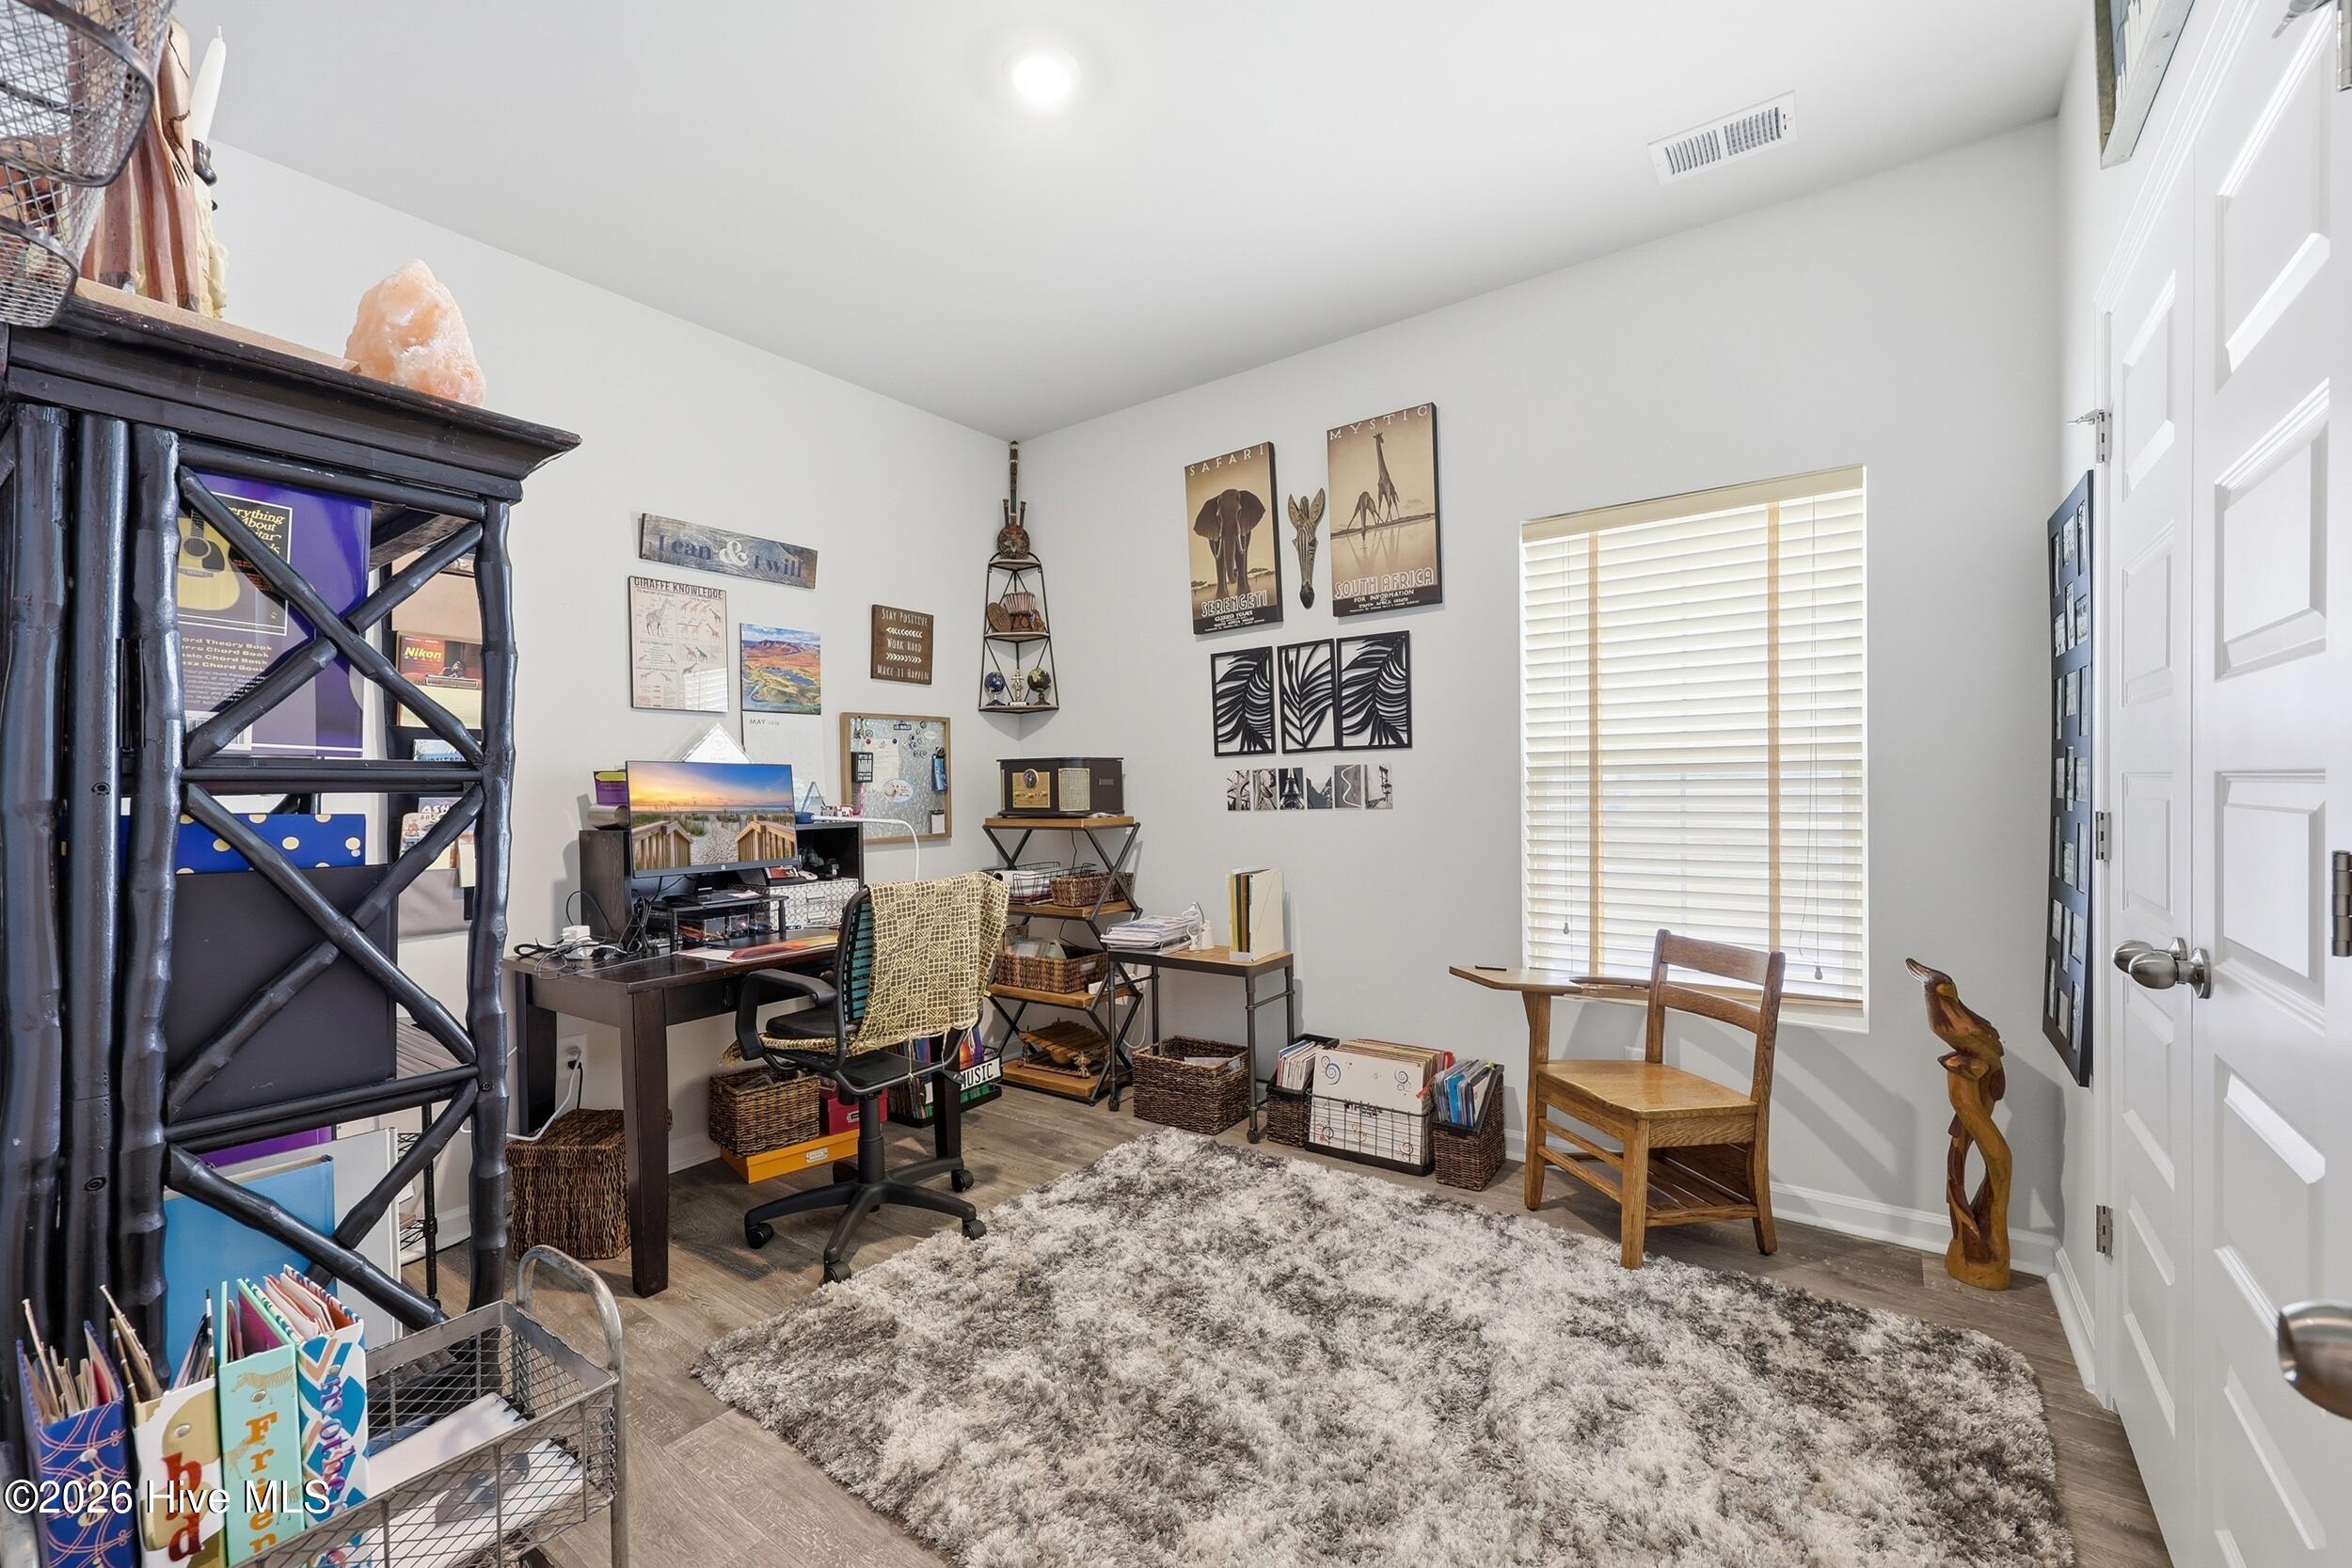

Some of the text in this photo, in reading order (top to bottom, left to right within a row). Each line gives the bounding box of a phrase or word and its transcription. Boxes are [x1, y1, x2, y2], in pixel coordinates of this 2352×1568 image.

[1329, 405, 1428, 440] MYSTIC
[1189, 445, 1263, 476] SAFARI
[229, 507, 286, 525] erything
[243, 517, 277, 532] About
[672, 539, 711, 562] can
[719, 540, 750, 567] &
[766, 556, 803, 578] will
[634, 577, 670, 591] GIRAFFE
[673, 582, 723, 599] KNOWLEDGE
[1335, 566, 1434, 599] SOUTH AFRICA
[1200, 589, 1268, 618] SERENGETI
[882, 608, 929, 626] STAY POSITIVE
[205, 639, 244, 650] Theory
[246, 642, 273, 652] Book
[206, 646, 241, 657] Chord
[405, 646, 442, 659] Nikon
[887, 638, 904, 651] WORK
[202, 661, 236, 671] Chord
[204, 654, 239, 664] Chord
[877, 664, 893, 676] MAKE
[907, 669, 930, 680] HAPPEN
